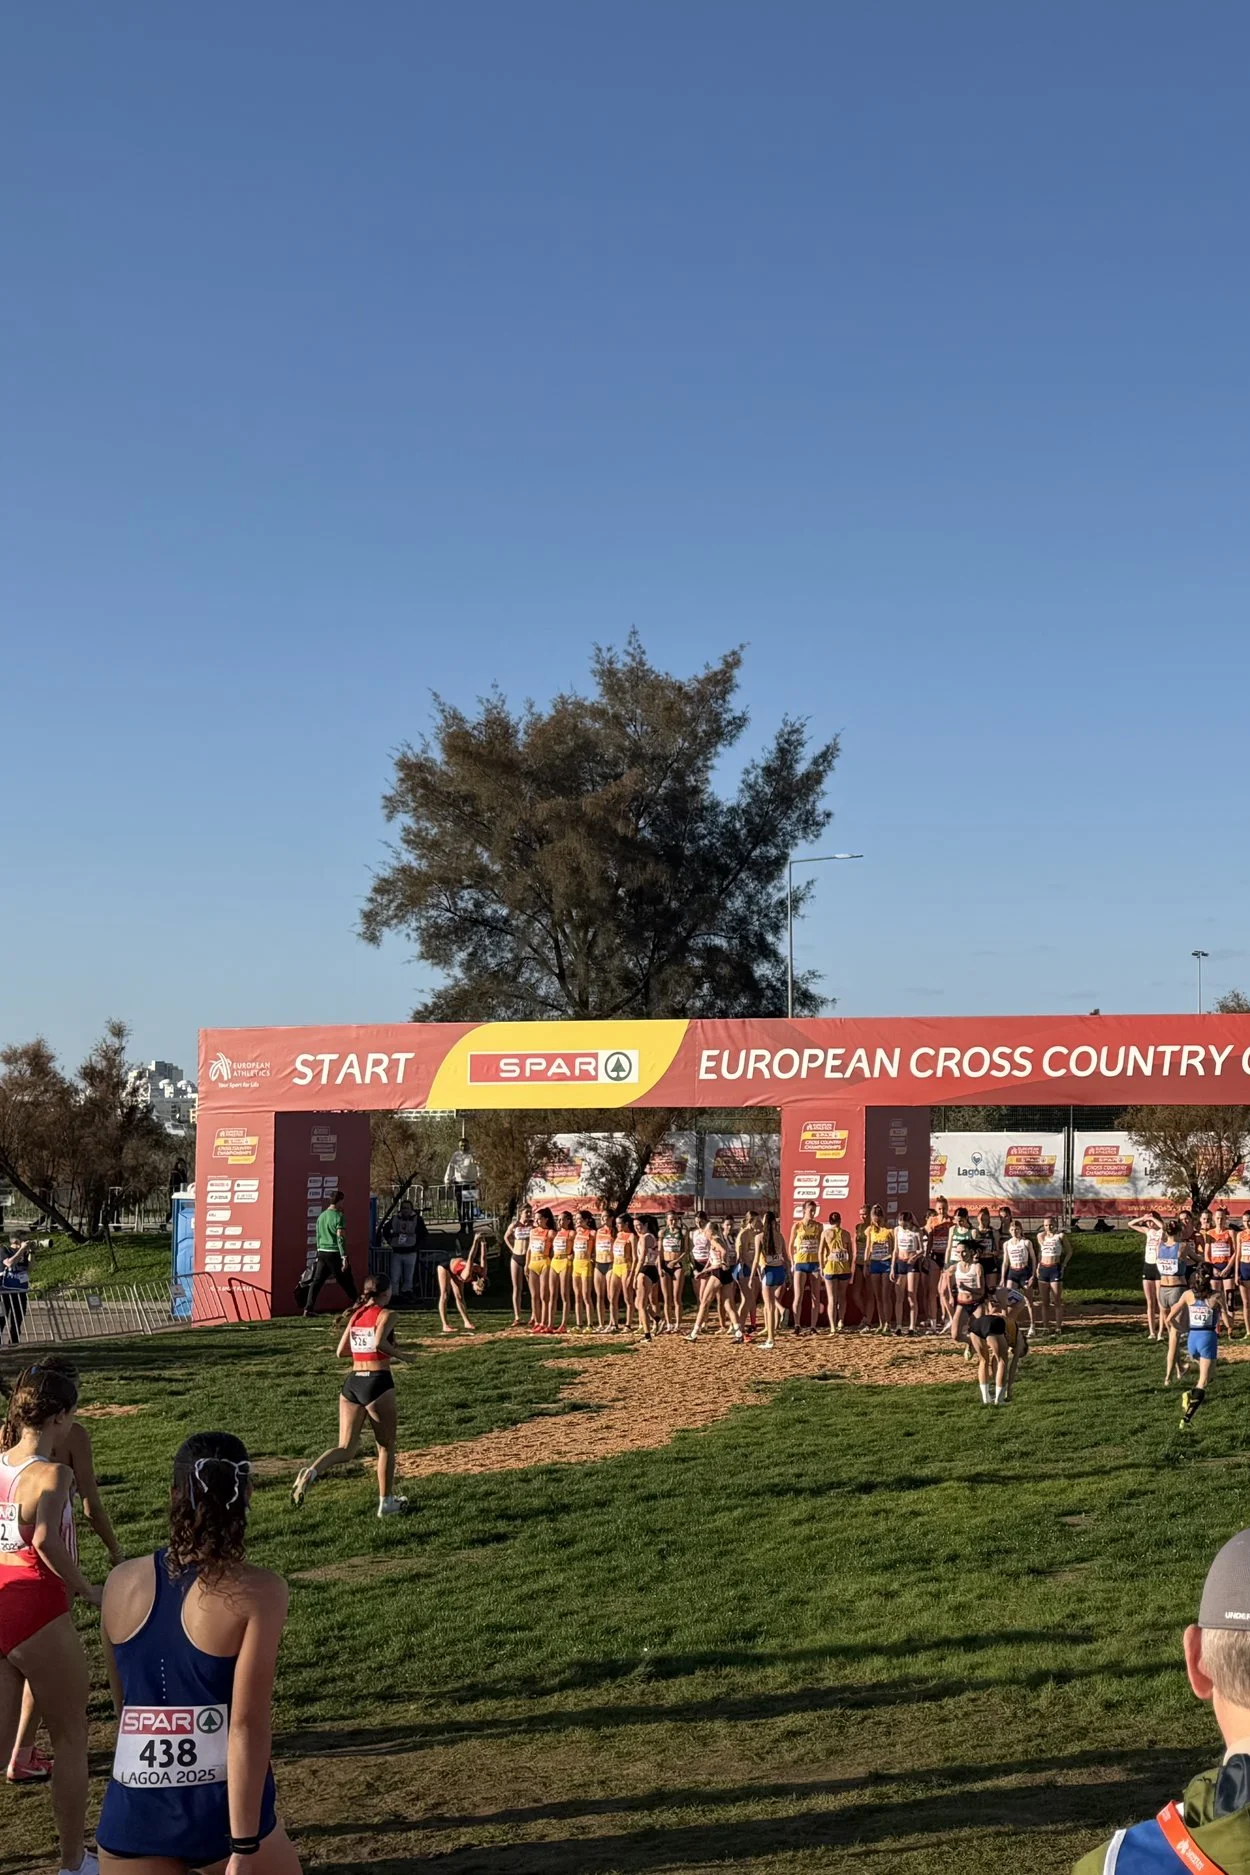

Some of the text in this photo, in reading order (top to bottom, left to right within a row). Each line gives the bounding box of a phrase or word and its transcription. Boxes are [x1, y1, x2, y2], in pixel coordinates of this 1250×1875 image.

[292, 1052, 415, 1086] START
[499, 1057, 597, 1078] SPAR
[698, 1048, 900, 1080] EUROPEAN
[910, 1046, 1032, 1078] CROSS
[1042, 1044, 1234, 1077] COUNTRY
[958, 1167, 985, 1178] Lagoa
[124, 1712, 192, 1731] SPAR
[139, 1738, 198, 1768] 438
[121, 1769, 216, 1785] LAGOA 2025
